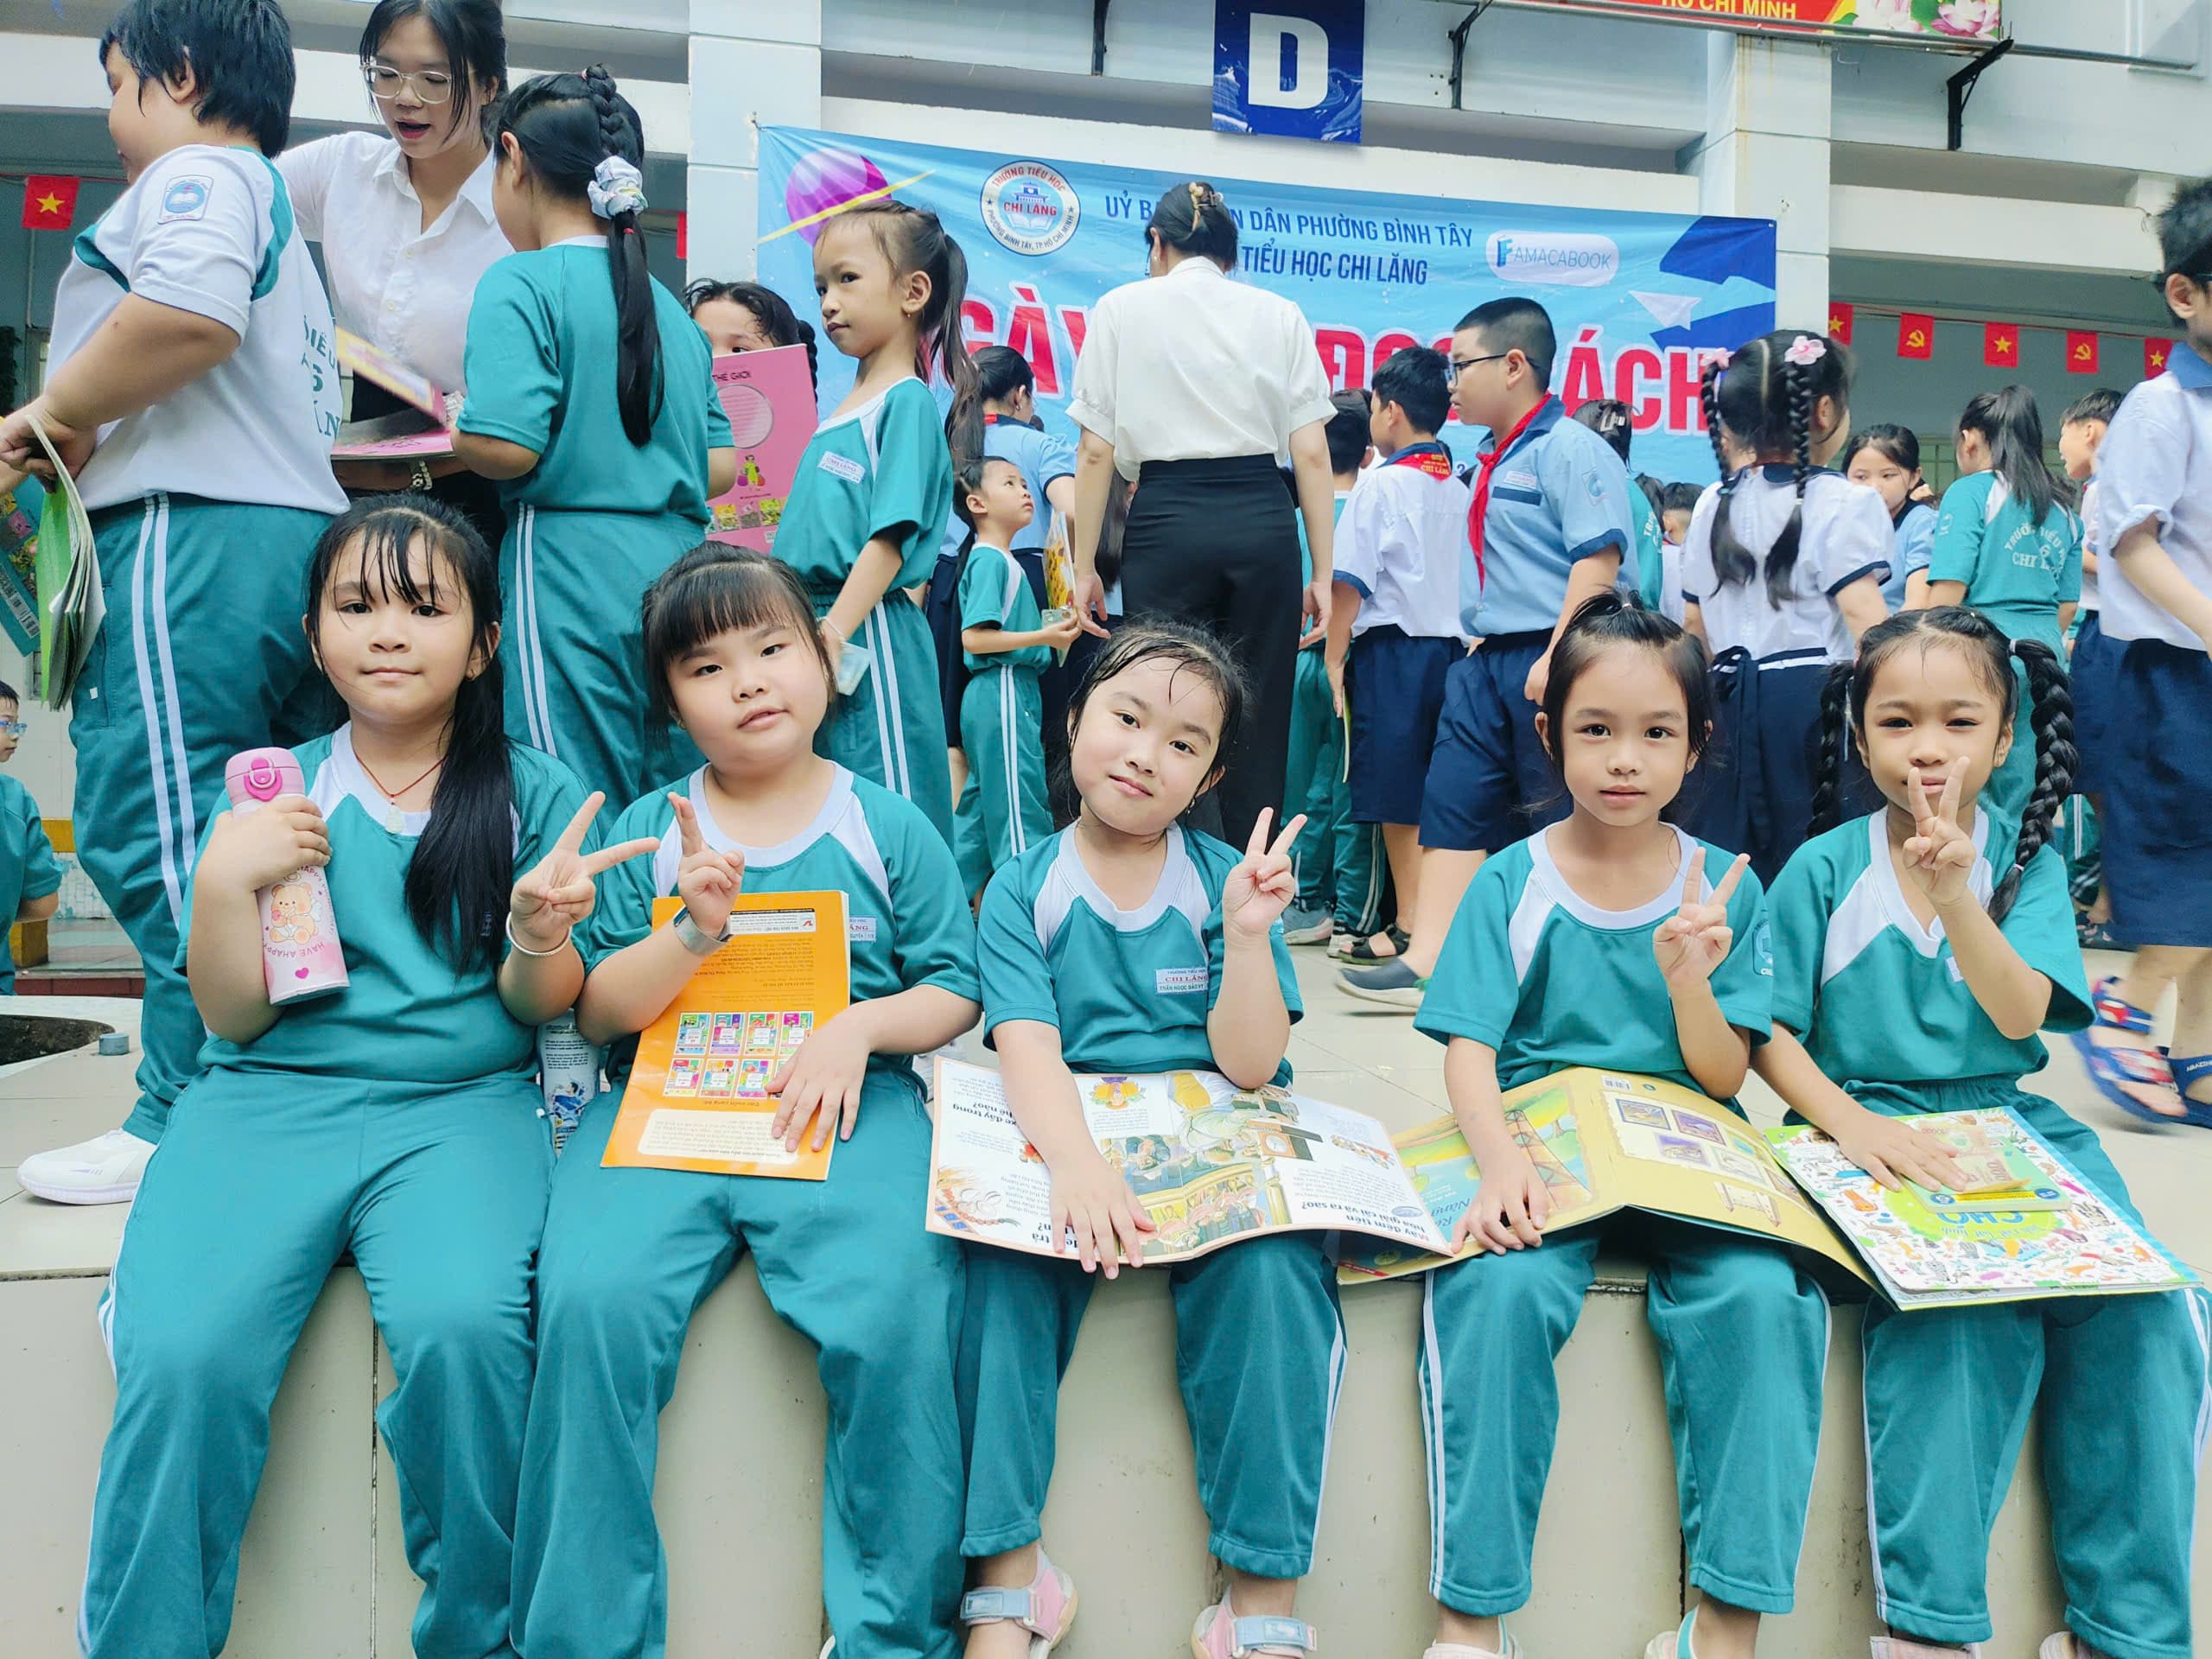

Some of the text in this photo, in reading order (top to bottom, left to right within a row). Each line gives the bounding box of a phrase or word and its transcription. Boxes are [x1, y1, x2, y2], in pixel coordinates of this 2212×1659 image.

[1743, 0, 1796, 20] MINH
[1248, 15, 1329, 110] D
[1003, 201, 1024, 213] CHI
[1249, 207, 1291, 233] DÂN
[1298, 213, 1378, 240] PHƯỜNG
[1383, 219, 1431, 245] BÌNH
[1435, 223, 1472, 247] TÂY
[1242, 237, 1428, 285] TIỂU HỌC CHI LĂNG
[1497, 237, 1611, 270] FAMACABOOK
[1560, 329, 1710, 430] ÁCH
[2012, 551, 2037, 568] CHI
[953, 1103, 982, 1117] trong
[1300, 1200, 1327, 1211] sao?
